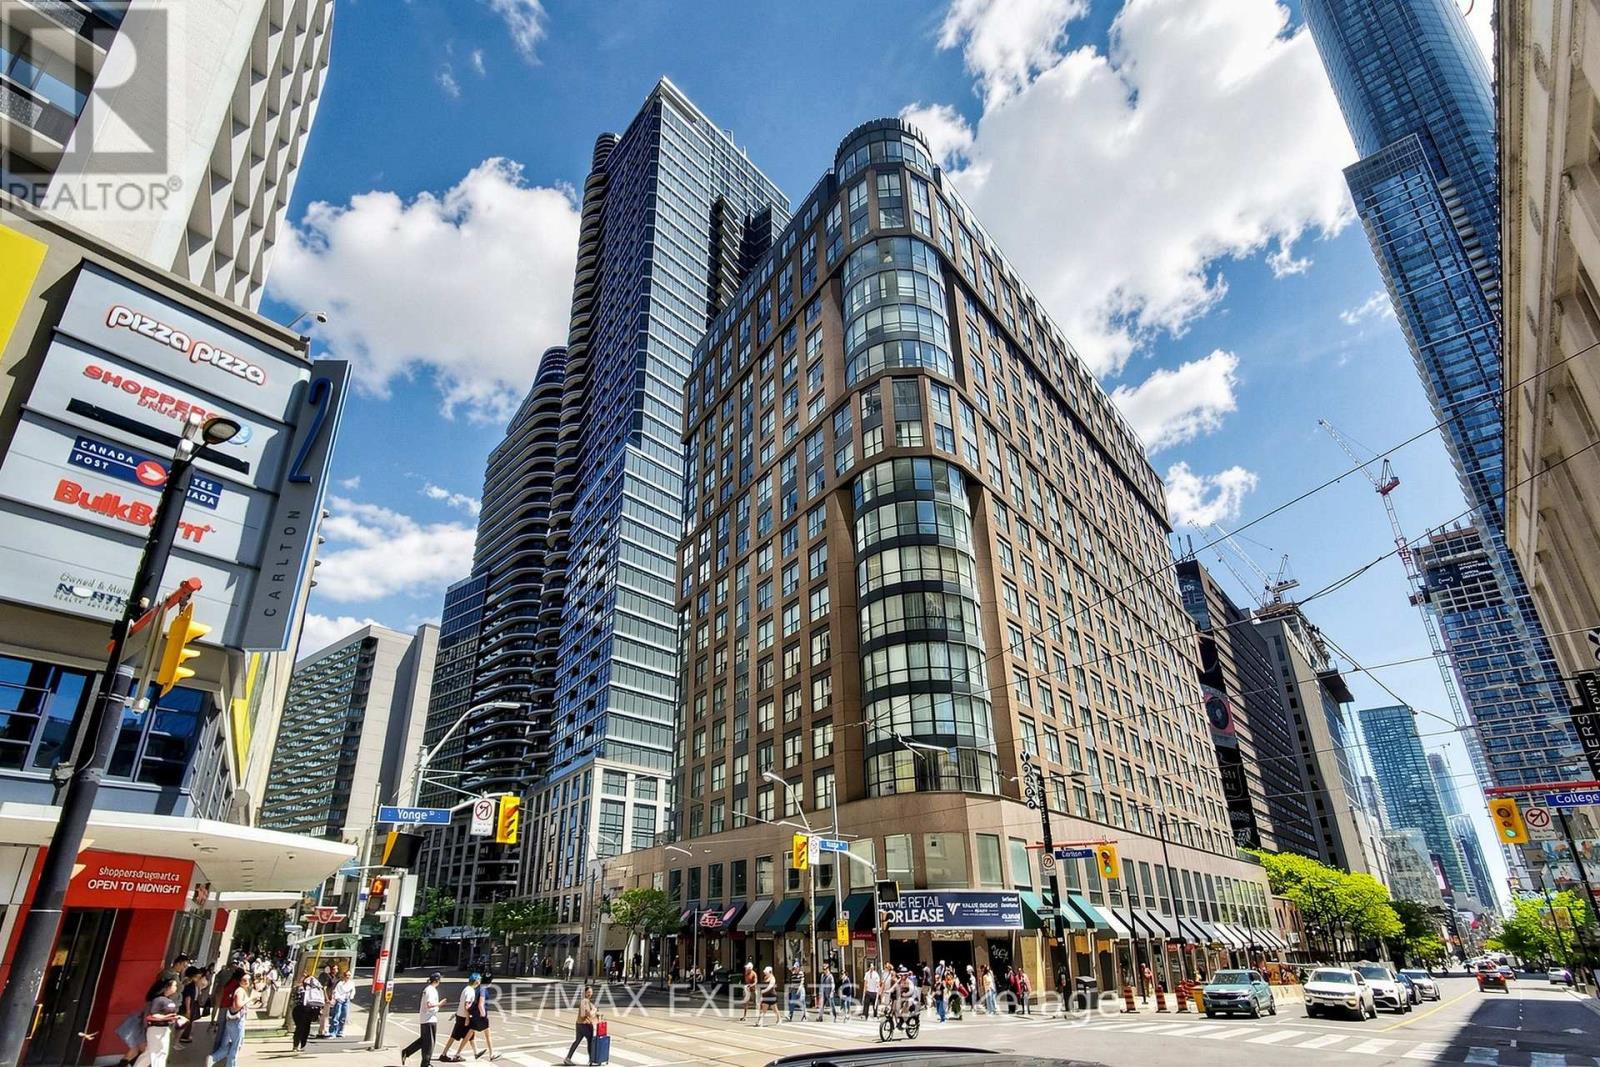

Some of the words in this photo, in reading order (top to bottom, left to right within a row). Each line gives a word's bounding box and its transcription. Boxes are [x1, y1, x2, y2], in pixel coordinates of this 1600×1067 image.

[83, 364, 219, 424] SHOPPERS
[288, 377, 333, 483] 2
[80, 440, 134, 465] CANADA
[75, 453, 110, 470] POST
[263, 510, 301, 617] CARLTON
[1555, 793, 1600, 803] College
[397, 809, 428, 822] Yonge
[87, 879, 119, 891] OPEN
[120, 881, 135, 892] TO
[135, 882, 182, 894] MIDNIGHT
[908, 896, 943, 908] RETAIL
[904, 908, 944, 923] LEASE
